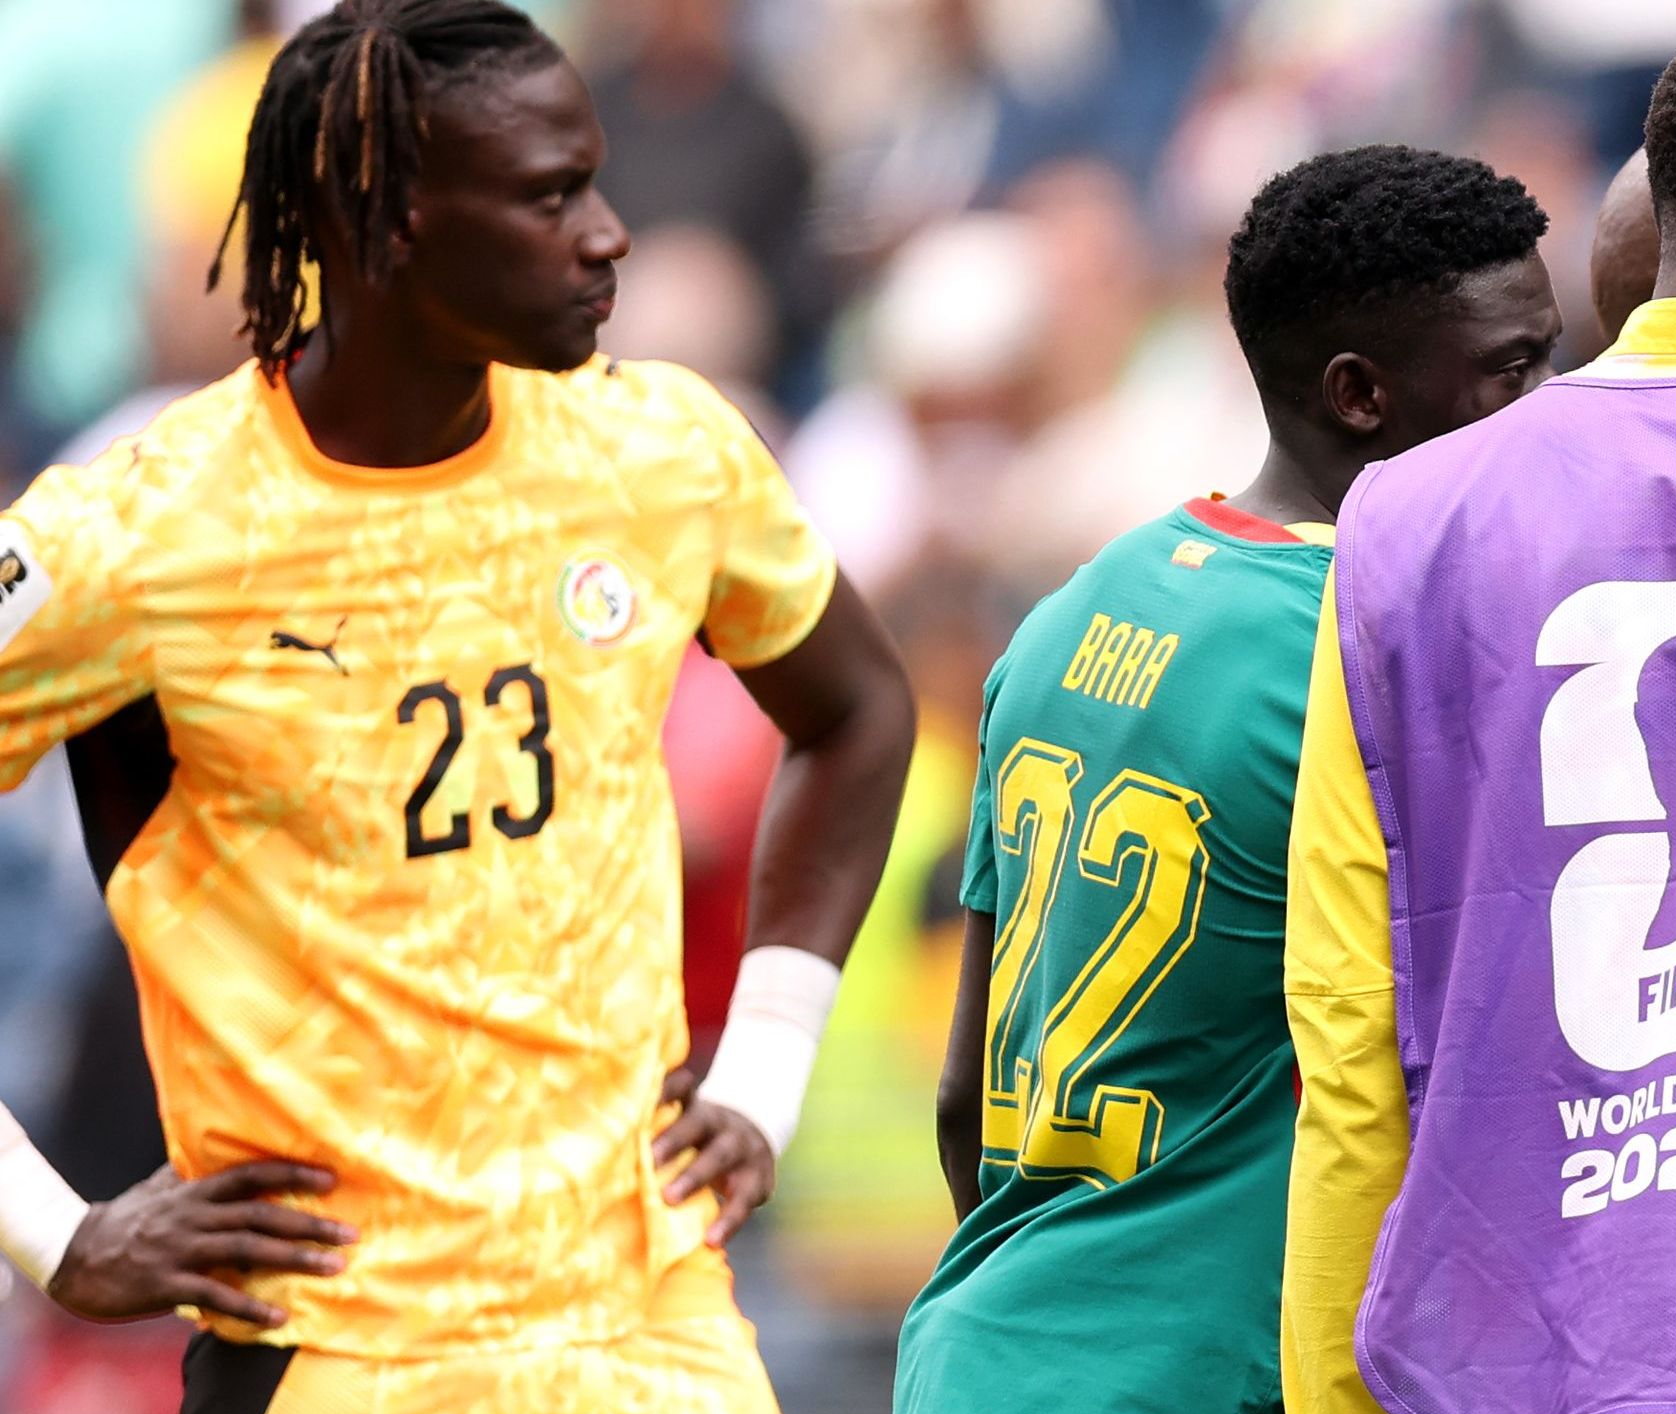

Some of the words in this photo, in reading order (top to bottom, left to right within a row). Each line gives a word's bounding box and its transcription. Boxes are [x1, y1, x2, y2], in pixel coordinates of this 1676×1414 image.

[1061, 611, 1180, 709] BARA
[396, 663, 556, 859] 23
[982, 735, 1212, 1191] 22
